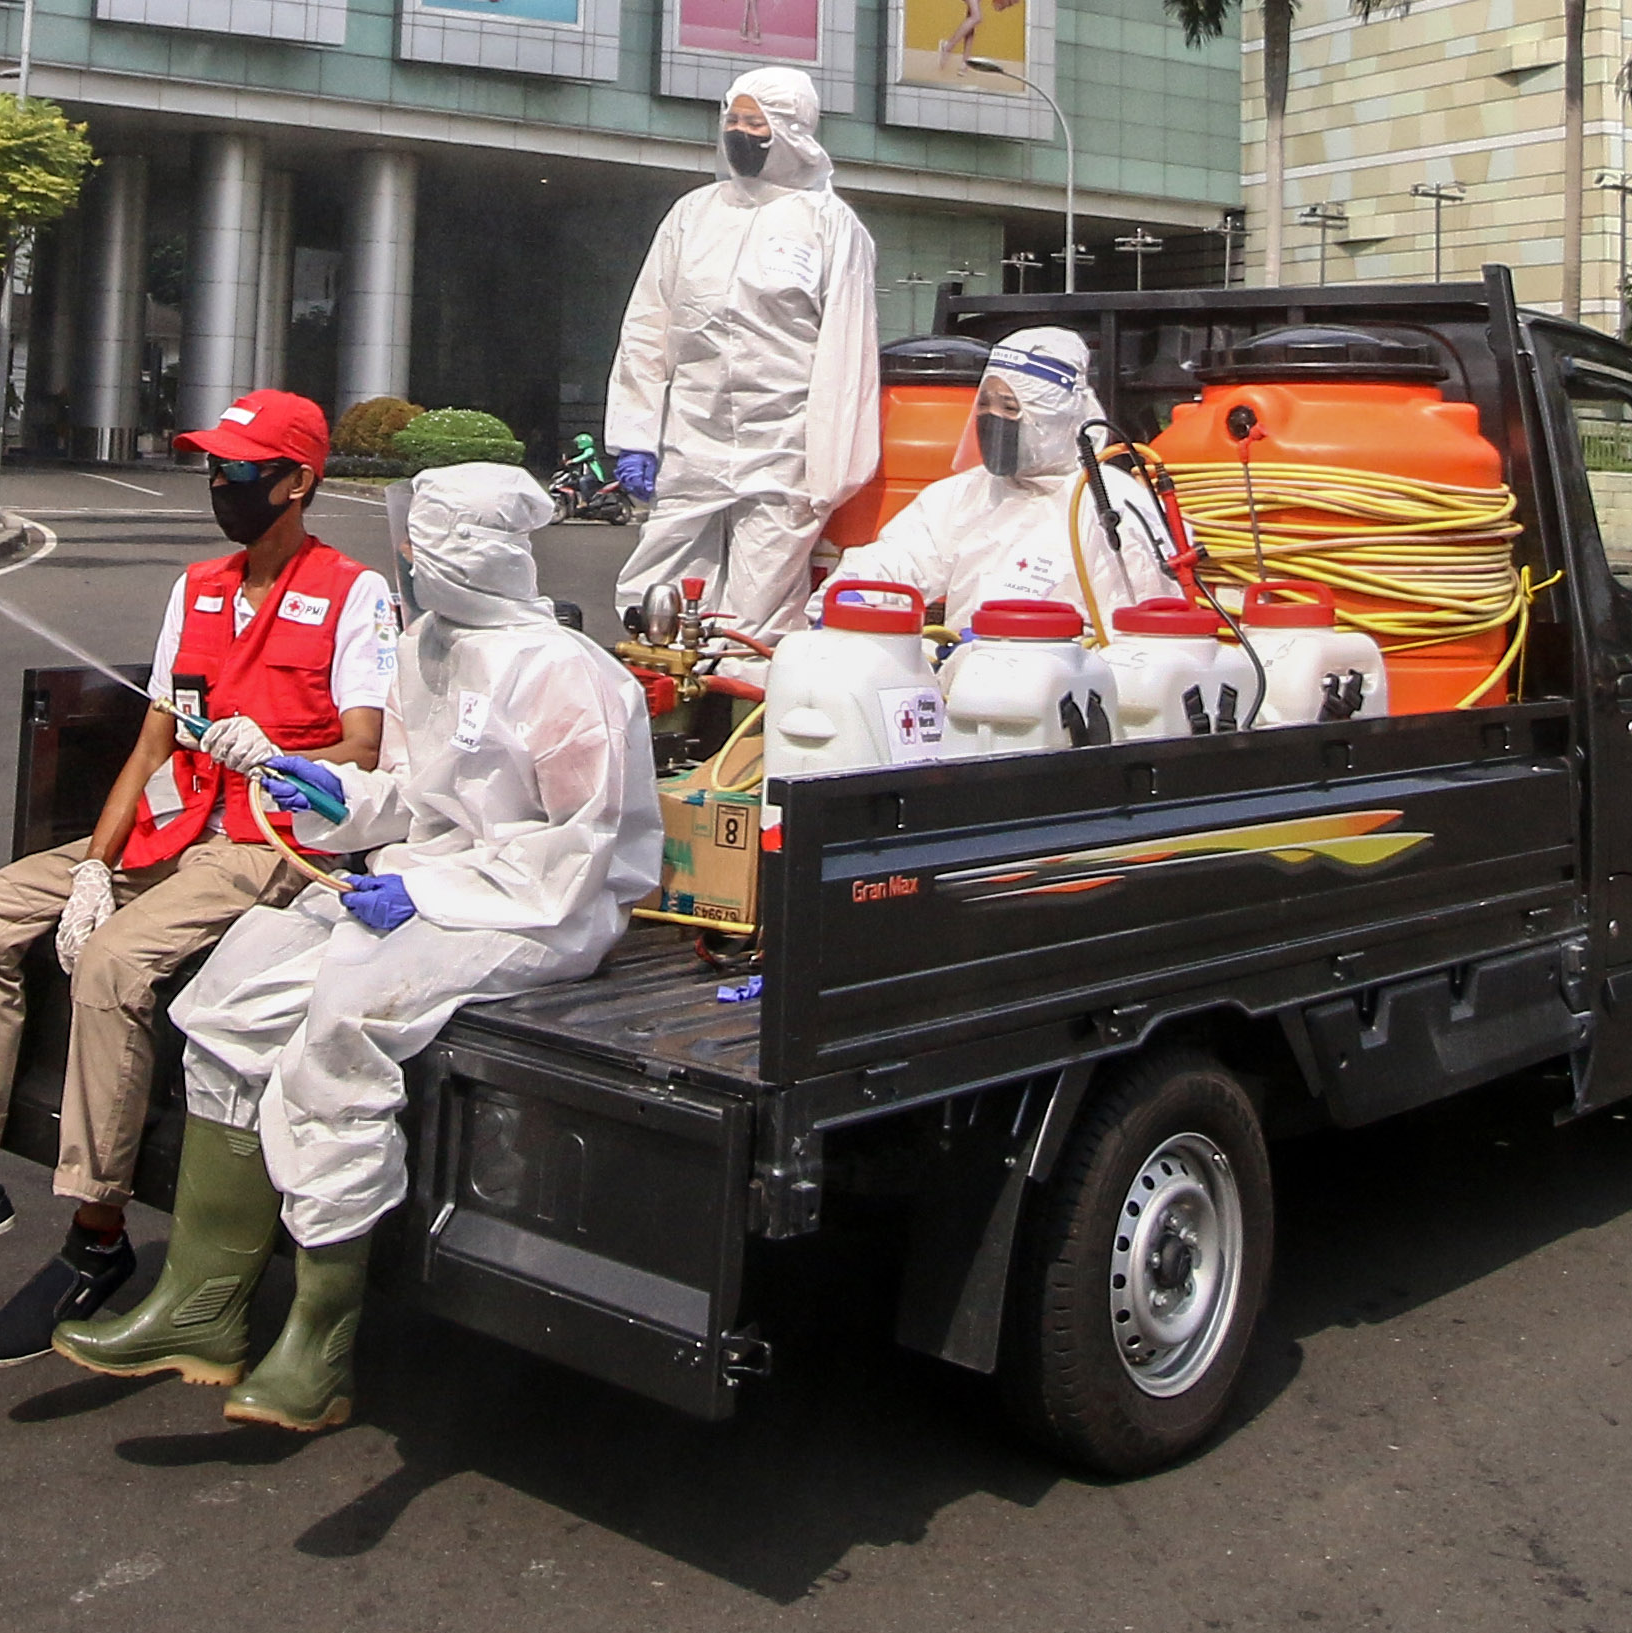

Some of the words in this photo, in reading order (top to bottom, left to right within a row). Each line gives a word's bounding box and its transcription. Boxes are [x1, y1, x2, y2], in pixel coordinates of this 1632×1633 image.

[725, 817, 739, 845] 8
[852, 879, 887, 903] Gran
[888, 874, 919, 897] Max
